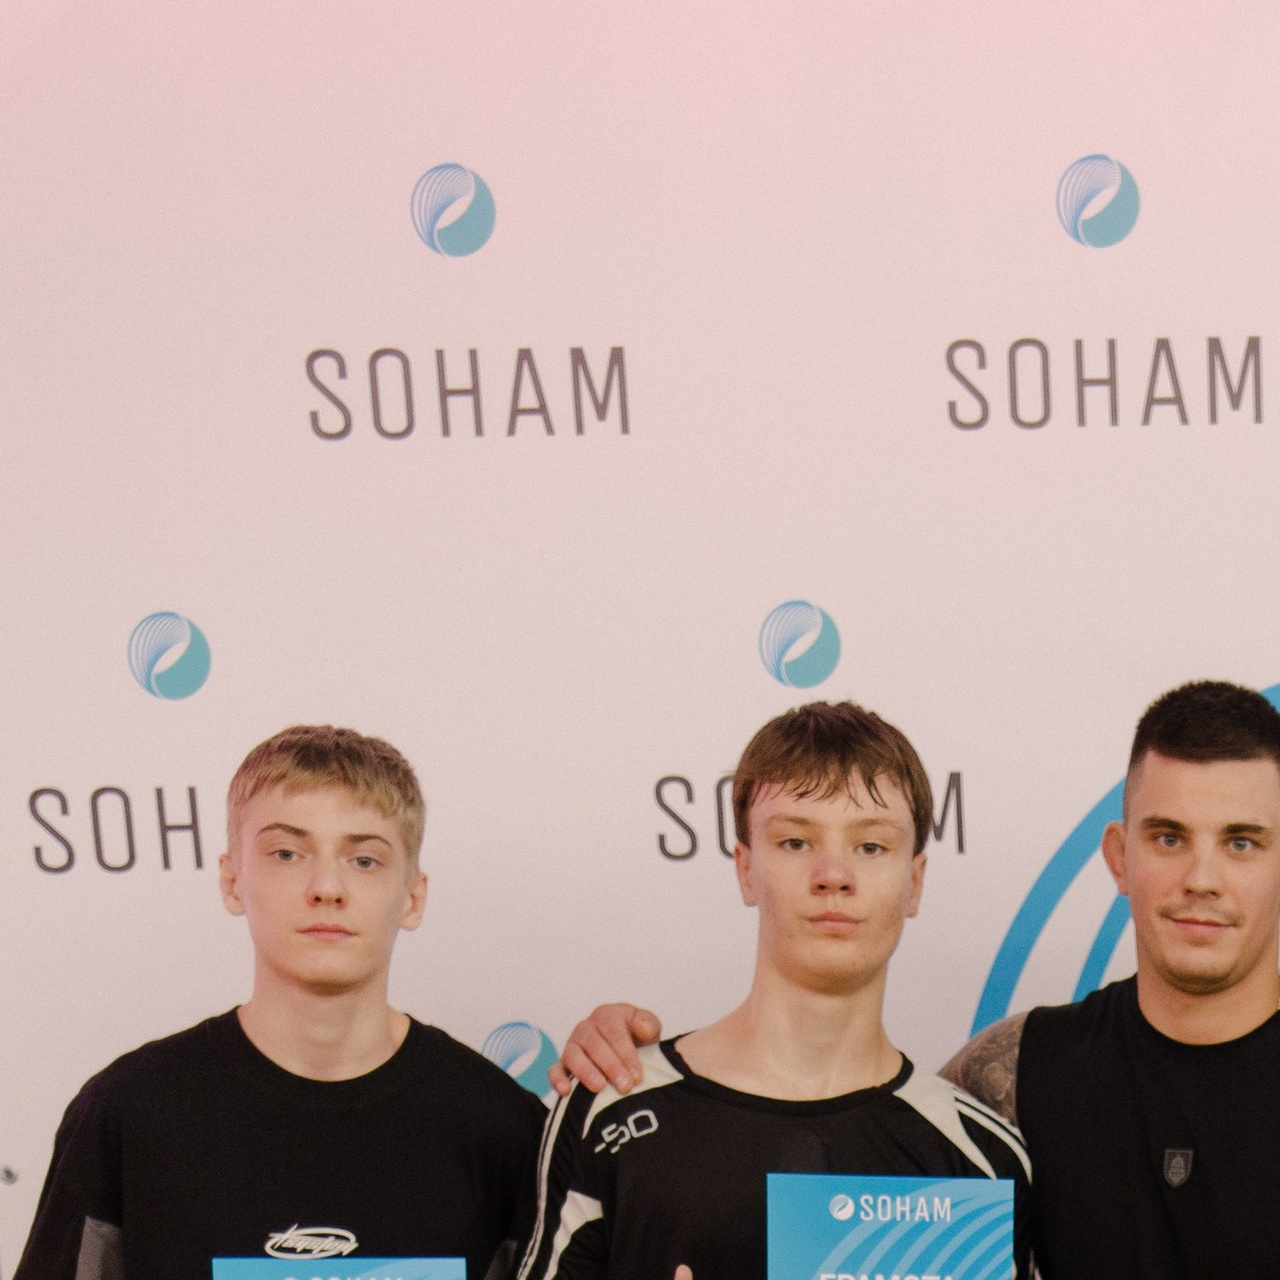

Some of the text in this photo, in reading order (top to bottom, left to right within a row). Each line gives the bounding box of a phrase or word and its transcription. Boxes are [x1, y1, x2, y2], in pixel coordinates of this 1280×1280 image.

[304, 345, 632, 441] SOHAM
[945, 335, 1266, 431] SOHAM
[29, 786, 203, 873] SOH
[860, 1195, 951, 1222] SOHAM
